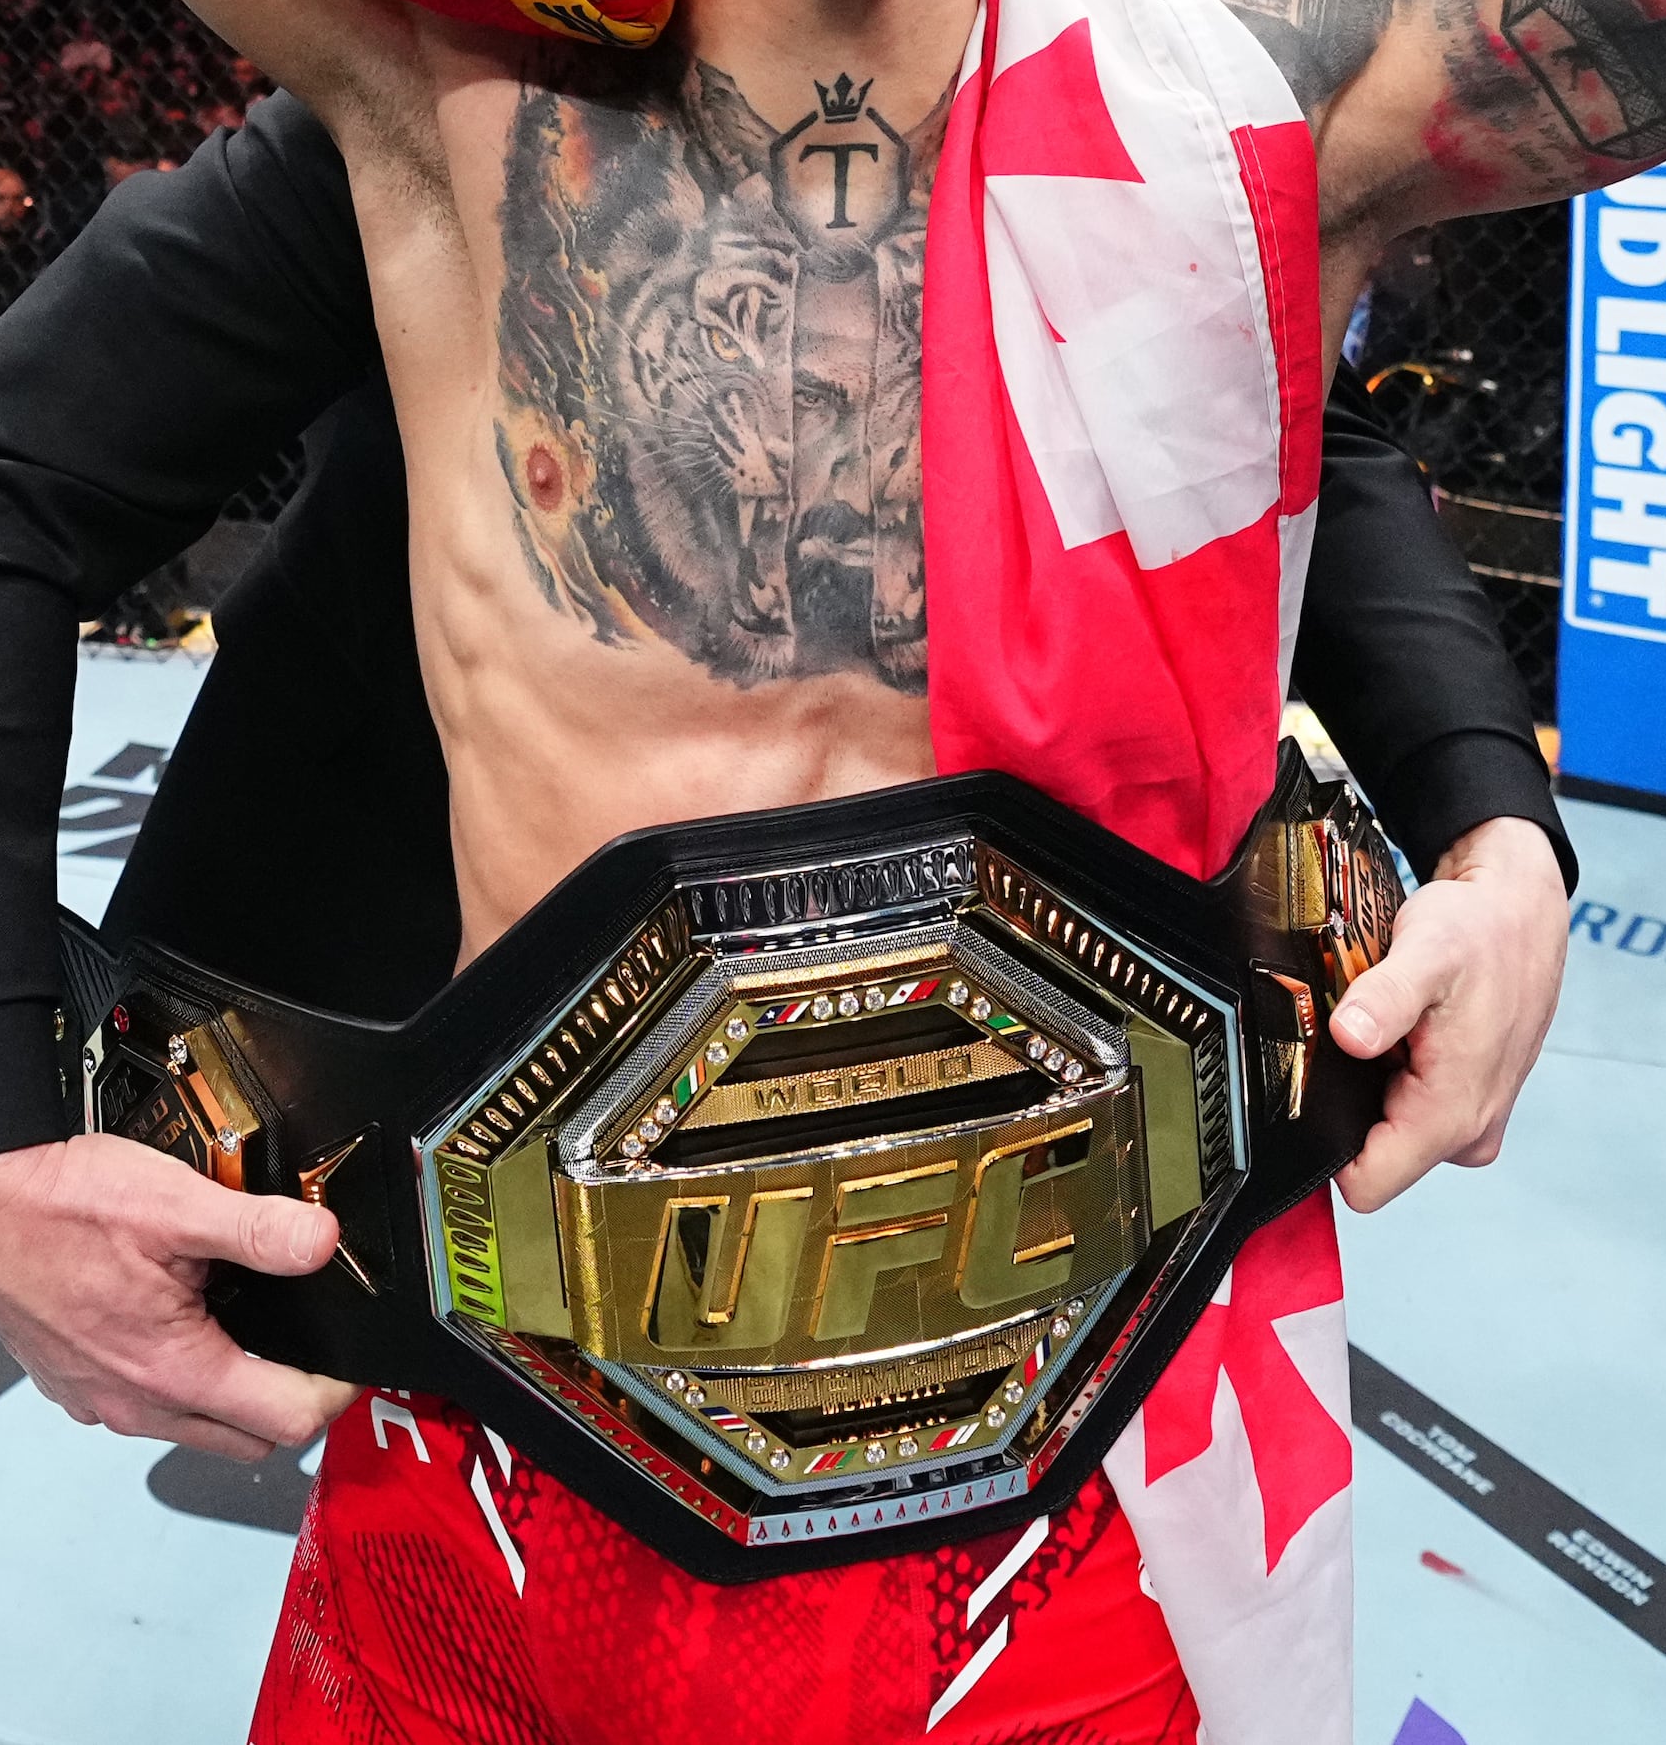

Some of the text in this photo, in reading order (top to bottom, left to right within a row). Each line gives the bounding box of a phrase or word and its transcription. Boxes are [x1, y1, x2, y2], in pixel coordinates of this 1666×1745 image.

[798, 142, 879, 229] T
[751, 1050, 974, 1112] WORLD
[639, 1116, 1095, 1353] UFC
[1380, 1410, 1496, 1497] COCHRANE
[1428, 1424, 1477, 1464] TOM
[1546, 1528, 1650, 1607] RENDON
[1571, 1528, 1655, 1590] EDWIN
